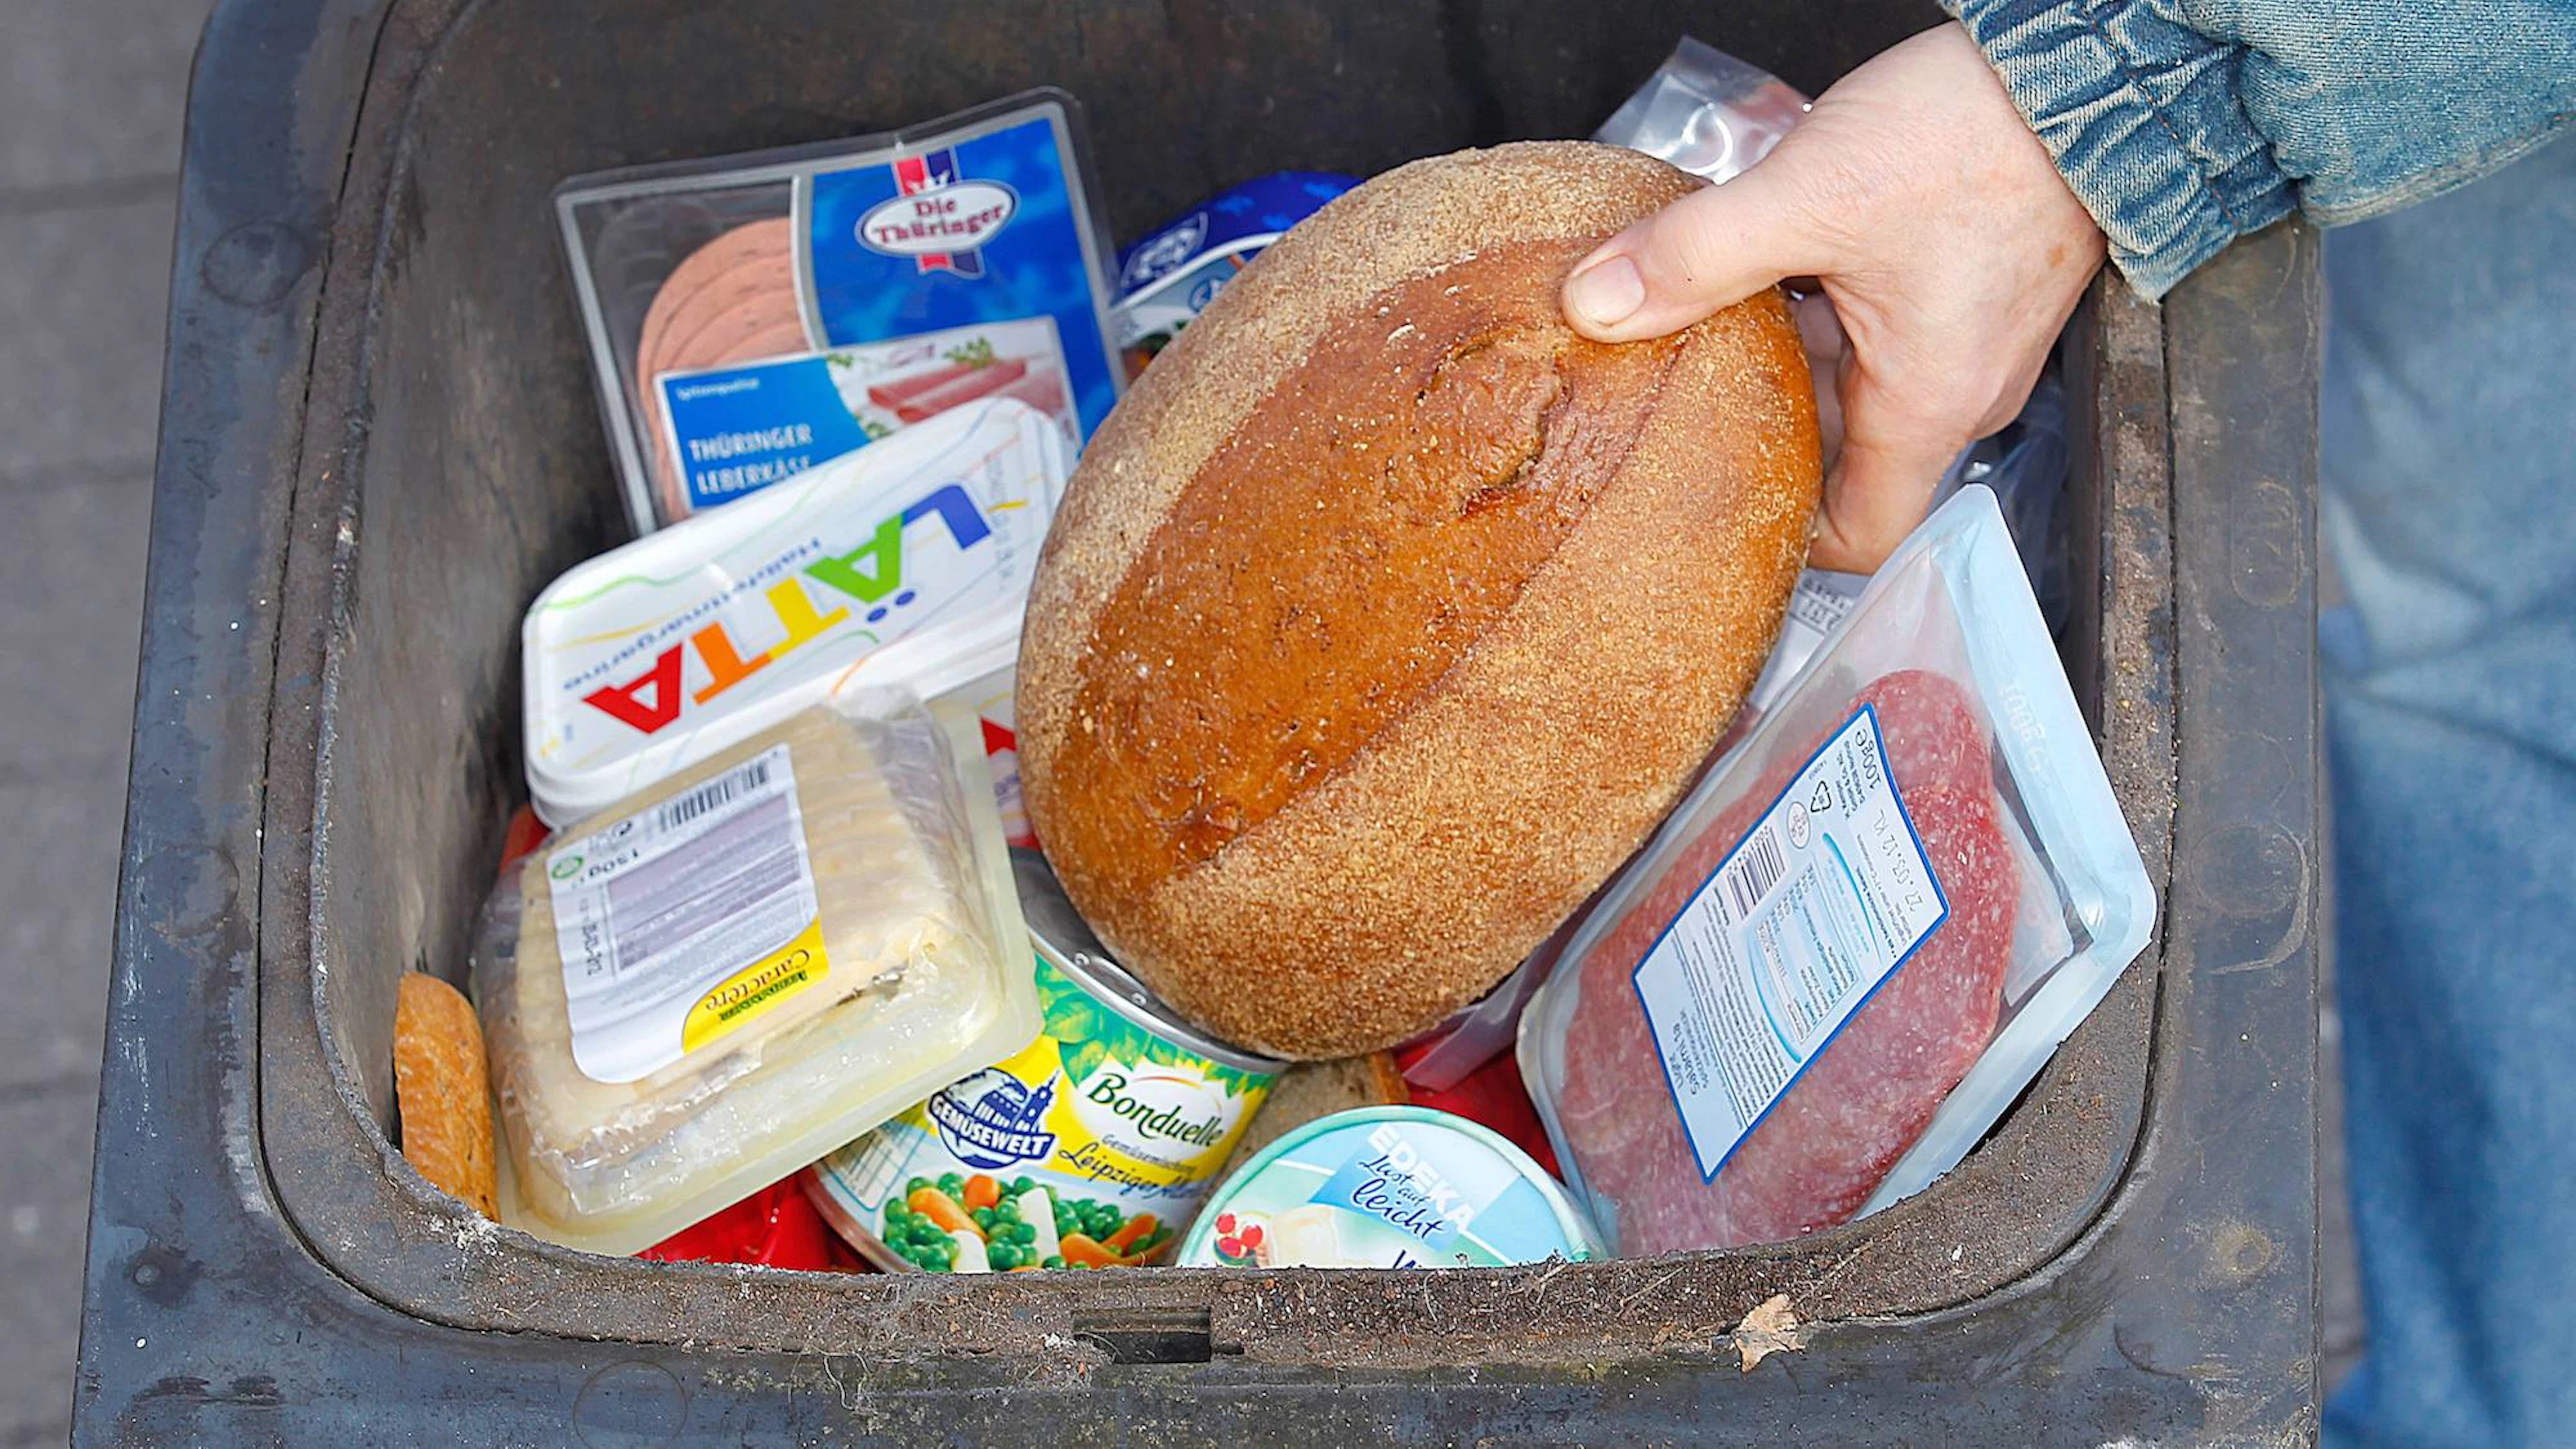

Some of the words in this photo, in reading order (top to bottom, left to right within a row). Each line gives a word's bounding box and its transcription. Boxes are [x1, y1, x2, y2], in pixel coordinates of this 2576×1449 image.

[875, 203, 1003, 244] Thüringer
[914, 198, 957, 217] Die
[688, 422, 814, 463] THÜRINGER
[580, 484, 991, 734] LÄTTA
[705, 948, 811, 1011] Caractère
[1677, 1039, 1699, 1095] Salami
[931, 1094, 1051, 1156] GEMÜSEWELT
[1087, 1073, 1223, 1146] Bonduelle
[1059, 1142, 1159, 1195] Leipziger
[1358, 1154, 1416, 1186] Lust
[1397, 1187, 1432, 1207] auf
[1368, 1122, 1475, 1232] EDEKA
[1352, 1178, 1444, 1240] leicht
